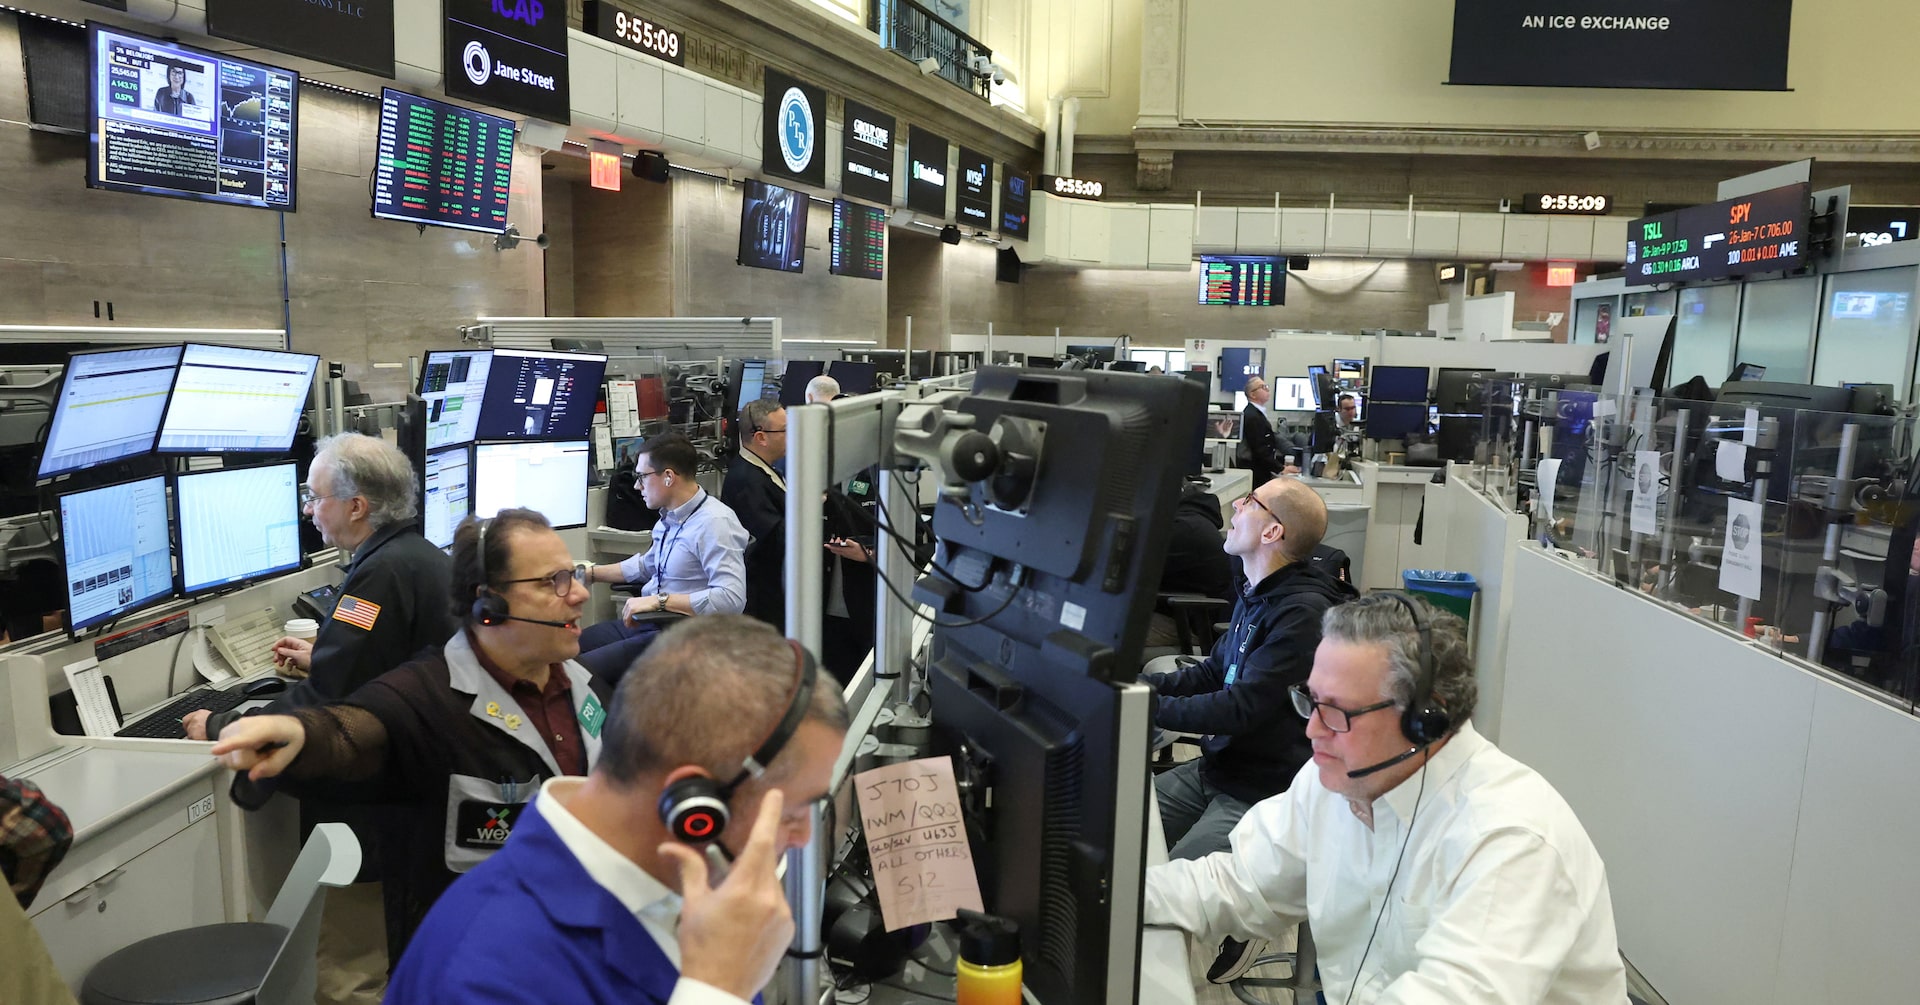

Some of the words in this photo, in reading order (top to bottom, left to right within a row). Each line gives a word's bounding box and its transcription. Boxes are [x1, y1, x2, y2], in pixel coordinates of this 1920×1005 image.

[1522, 16, 1544, 28] AN
[616, 12, 678, 58] 9:55:09
[111, 66, 138, 78] 25,545.08
[494, 60, 520, 81] Jane
[522, 68, 555, 90] Street
[115, 92, 134, 102] 0.57%
[788, 110, 805, 149] PTR
[1054, 178, 1102, 196] 9:55:09
[1540, 195, 1606, 210] 9:55:09
[1730, 203, 1751, 224] SPY
[1643, 222, 1663, 240] TSLL
[1729, 226, 1758, 244] 26-Jan-7
[1759, 226, 1765, 238] C
[1767, 220, 1792, 237] 706.00
[1672, 239, 1688, 254] 17.50
[1728, 250, 1740, 265] 100
[1741, 248, 1756, 262] 0.01
[1762, 244, 1778, 259] 0.01
[1778, 241, 1798, 258] AME
[1681, 256, 1700, 270] ARCA
[1732, 525, 1749, 538] STOP
[878, 858, 907, 872] ALL
[914, 846, 968, 862] OTHERS
